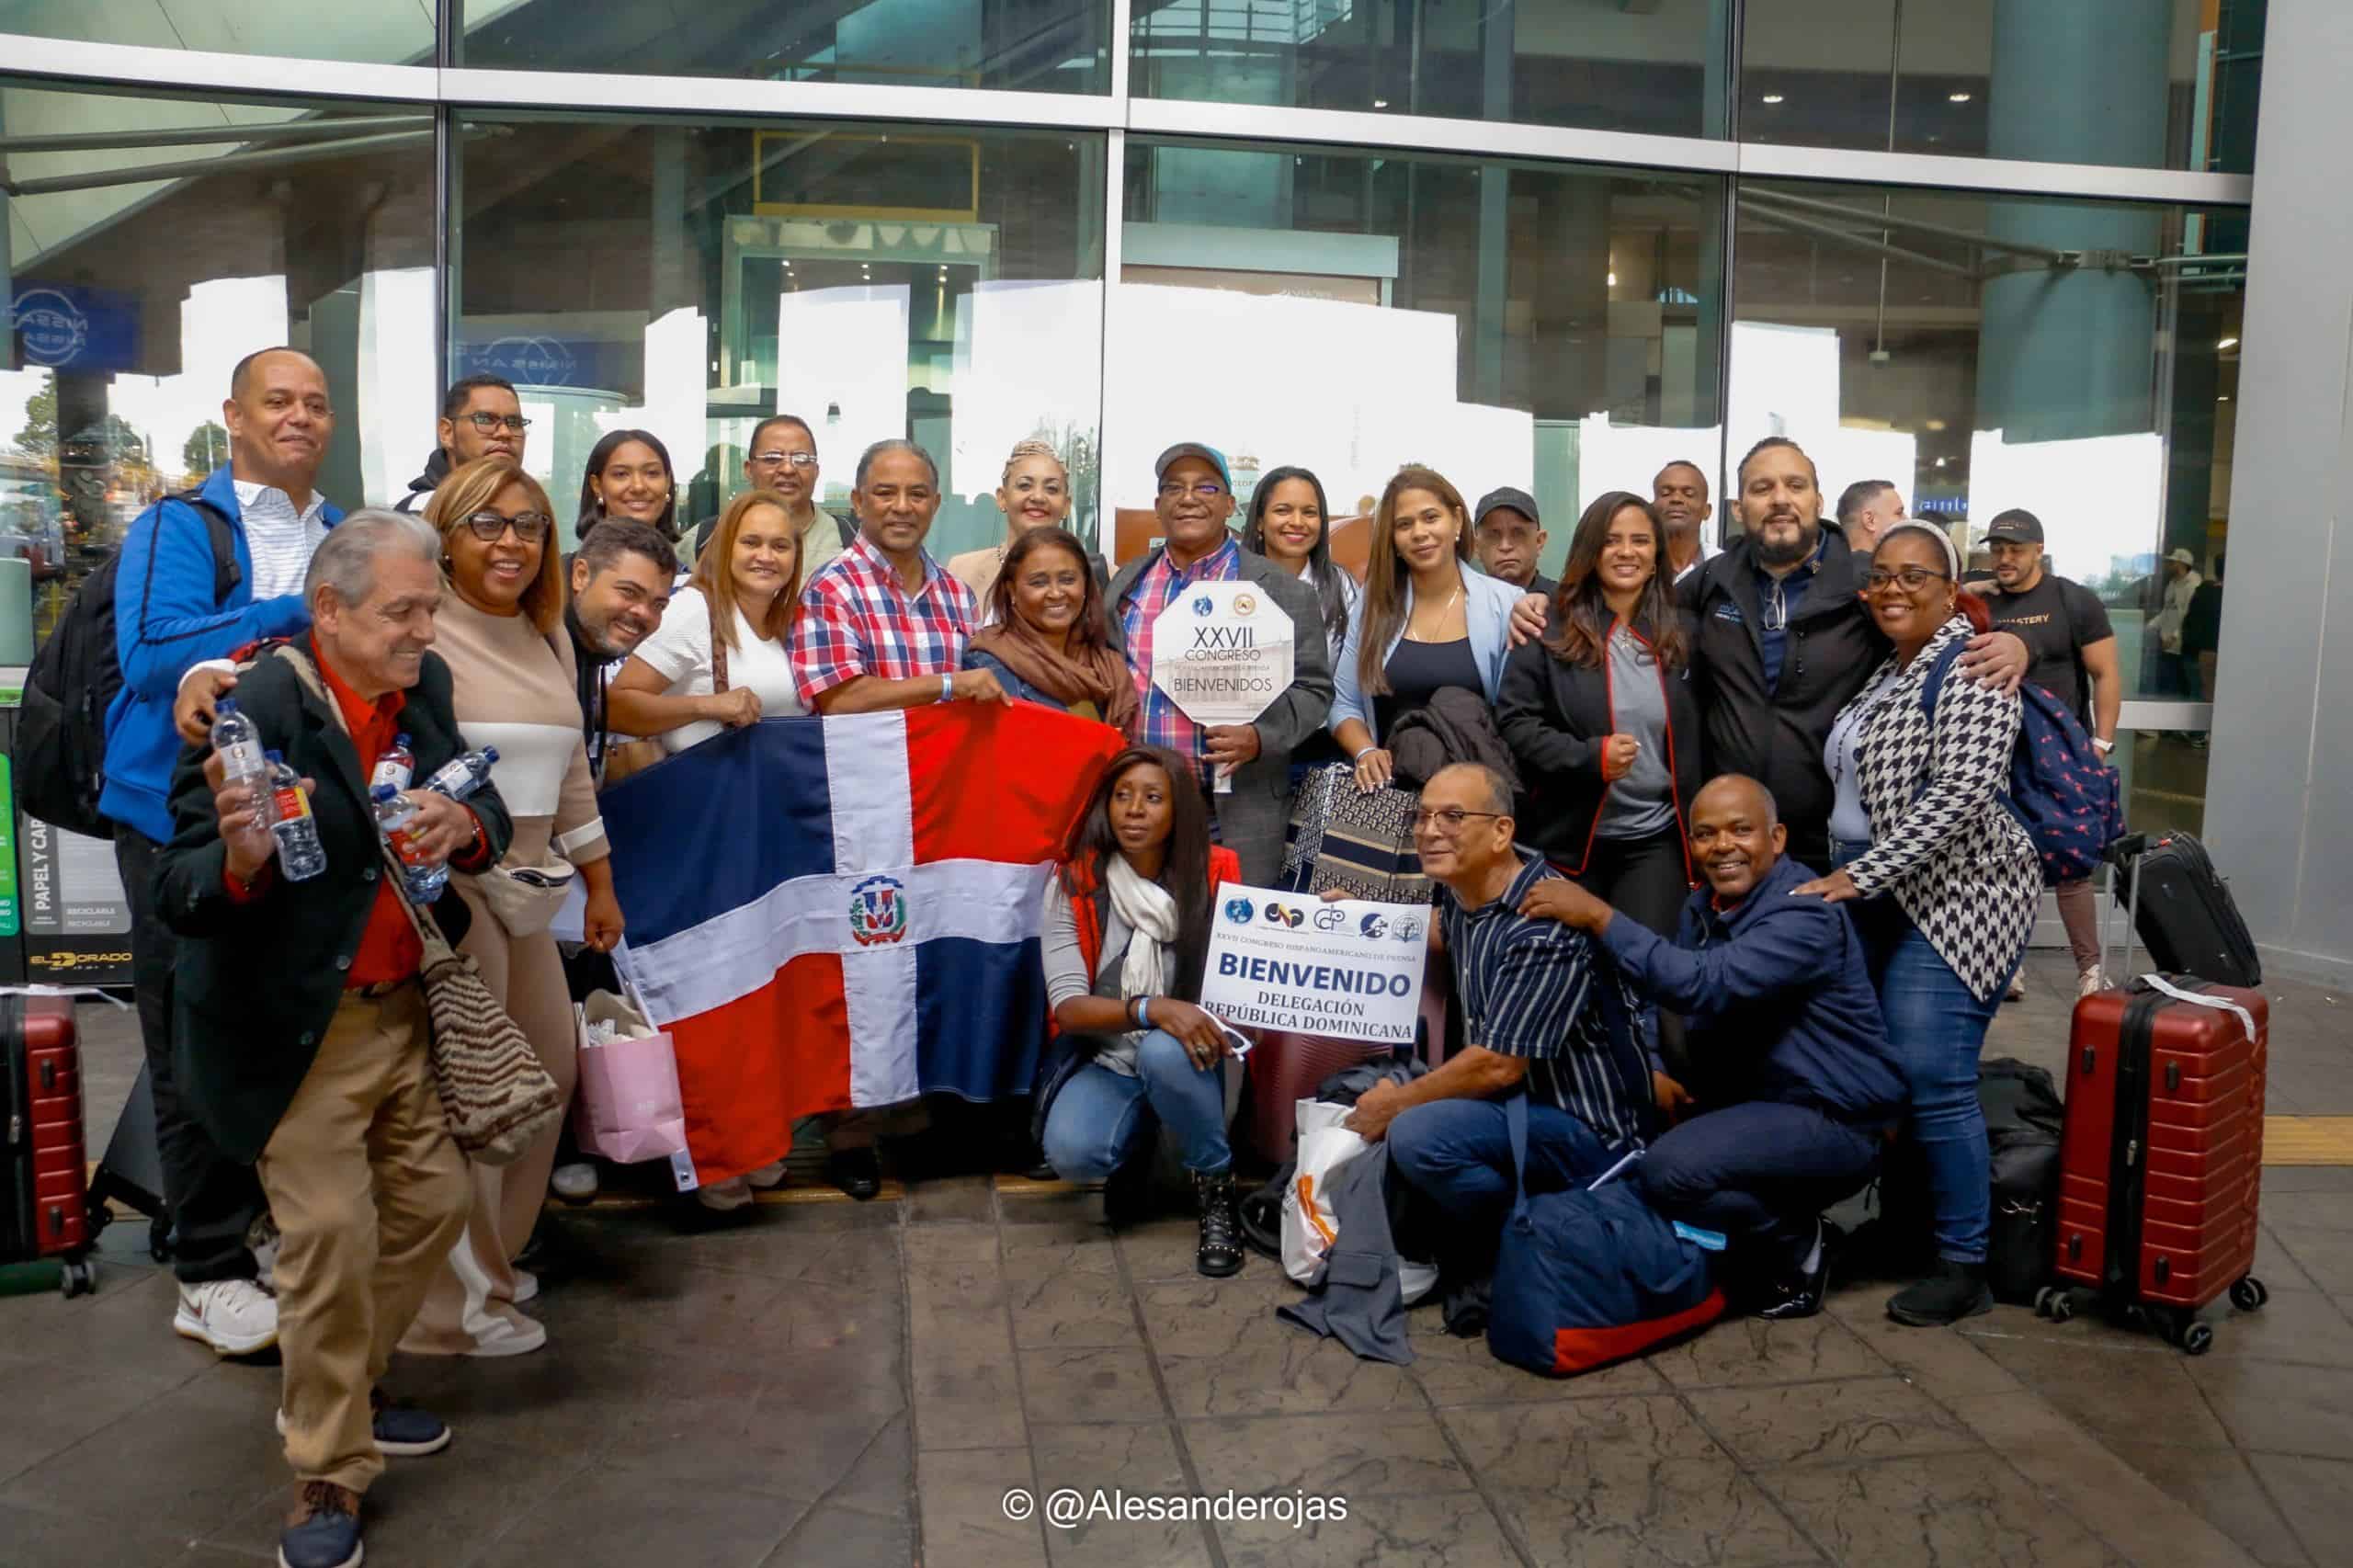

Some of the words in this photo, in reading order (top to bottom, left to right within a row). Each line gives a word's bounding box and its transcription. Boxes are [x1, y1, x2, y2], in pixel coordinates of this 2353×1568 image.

[1193, 627, 1253, 648] XXVII
[1185, 649, 1261, 662] CONGRESO
[1174, 678, 1272, 691] BIENVENIDOS
[31, 851, 49, 862] Y
[32, 864, 51, 911] PAPEL
[1240, 937, 1285, 949] CONGRESO
[1219, 952, 1411, 997] BIENVENIDO
[1257, 991, 1365, 1016] DELEGACIÓN
[1205, 1001, 1298, 1028] REPÚBLICA
[1303, 1017, 1413, 1039] DOMINICANA
